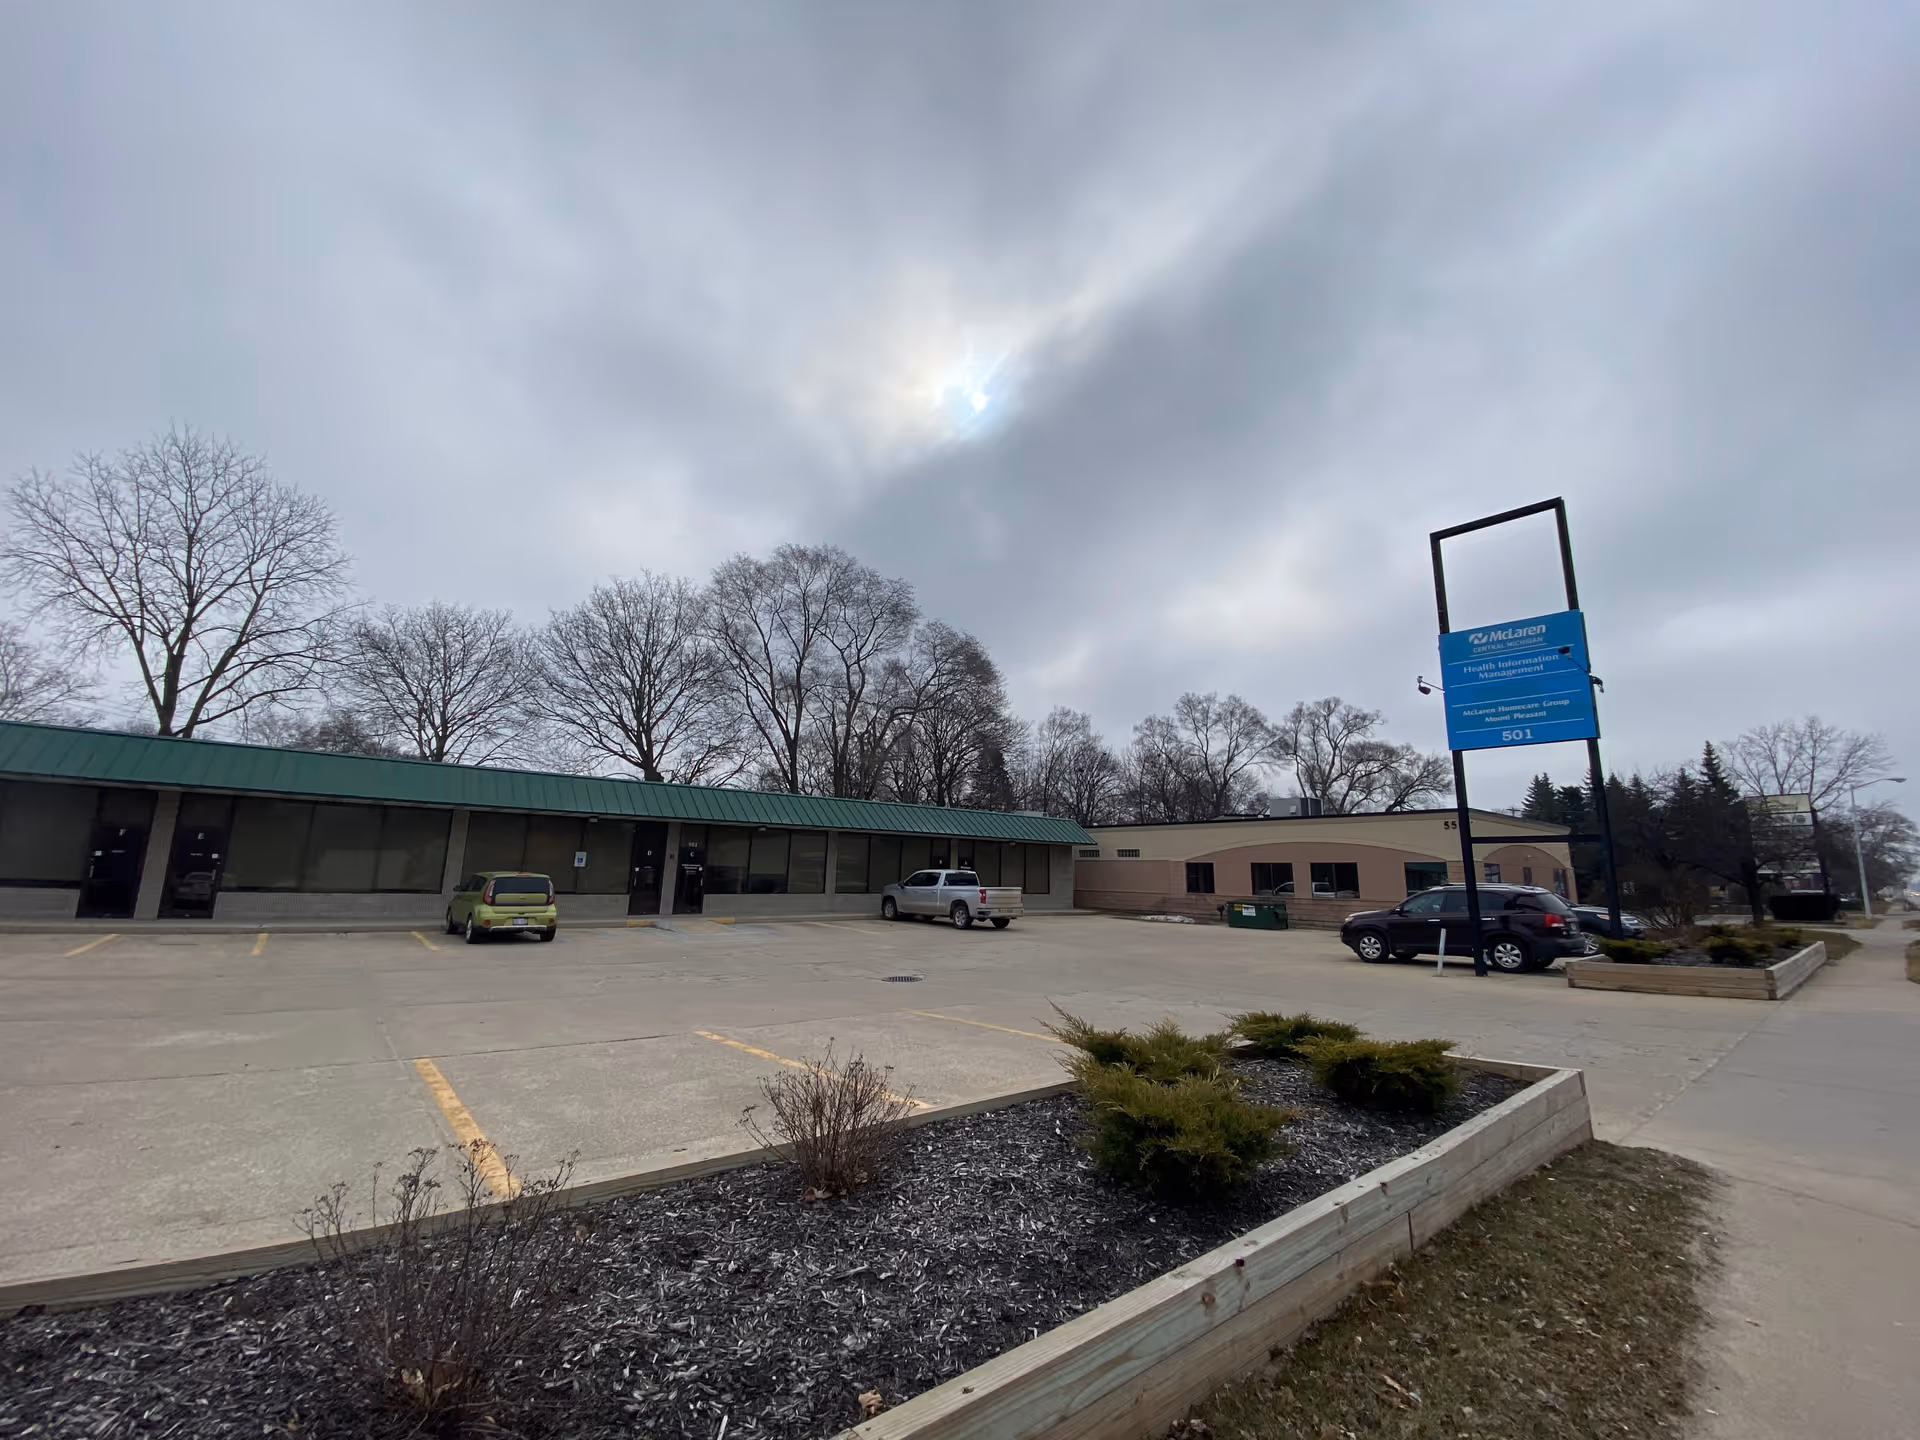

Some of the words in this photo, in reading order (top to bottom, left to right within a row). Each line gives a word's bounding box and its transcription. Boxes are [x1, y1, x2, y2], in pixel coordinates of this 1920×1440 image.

[1489, 624, 1546, 642] McLaren
[1473, 643, 1505, 653] CENTRAL
[1506, 636, 1543, 647] MICHIGAN
[1463, 662, 1495, 674] Health
[1498, 653, 1559, 668] Information
[1479, 664, 1544, 679] Management
[1463, 707, 1496, 717] McLaren
[1498, 703, 1540, 712] Homecare
[1543, 699, 1570, 708] Group
[1484, 714, 1511, 722] Mount
[1513, 711, 1547, 720] Pleasant
[1502, 729, 1535, 741] 501
